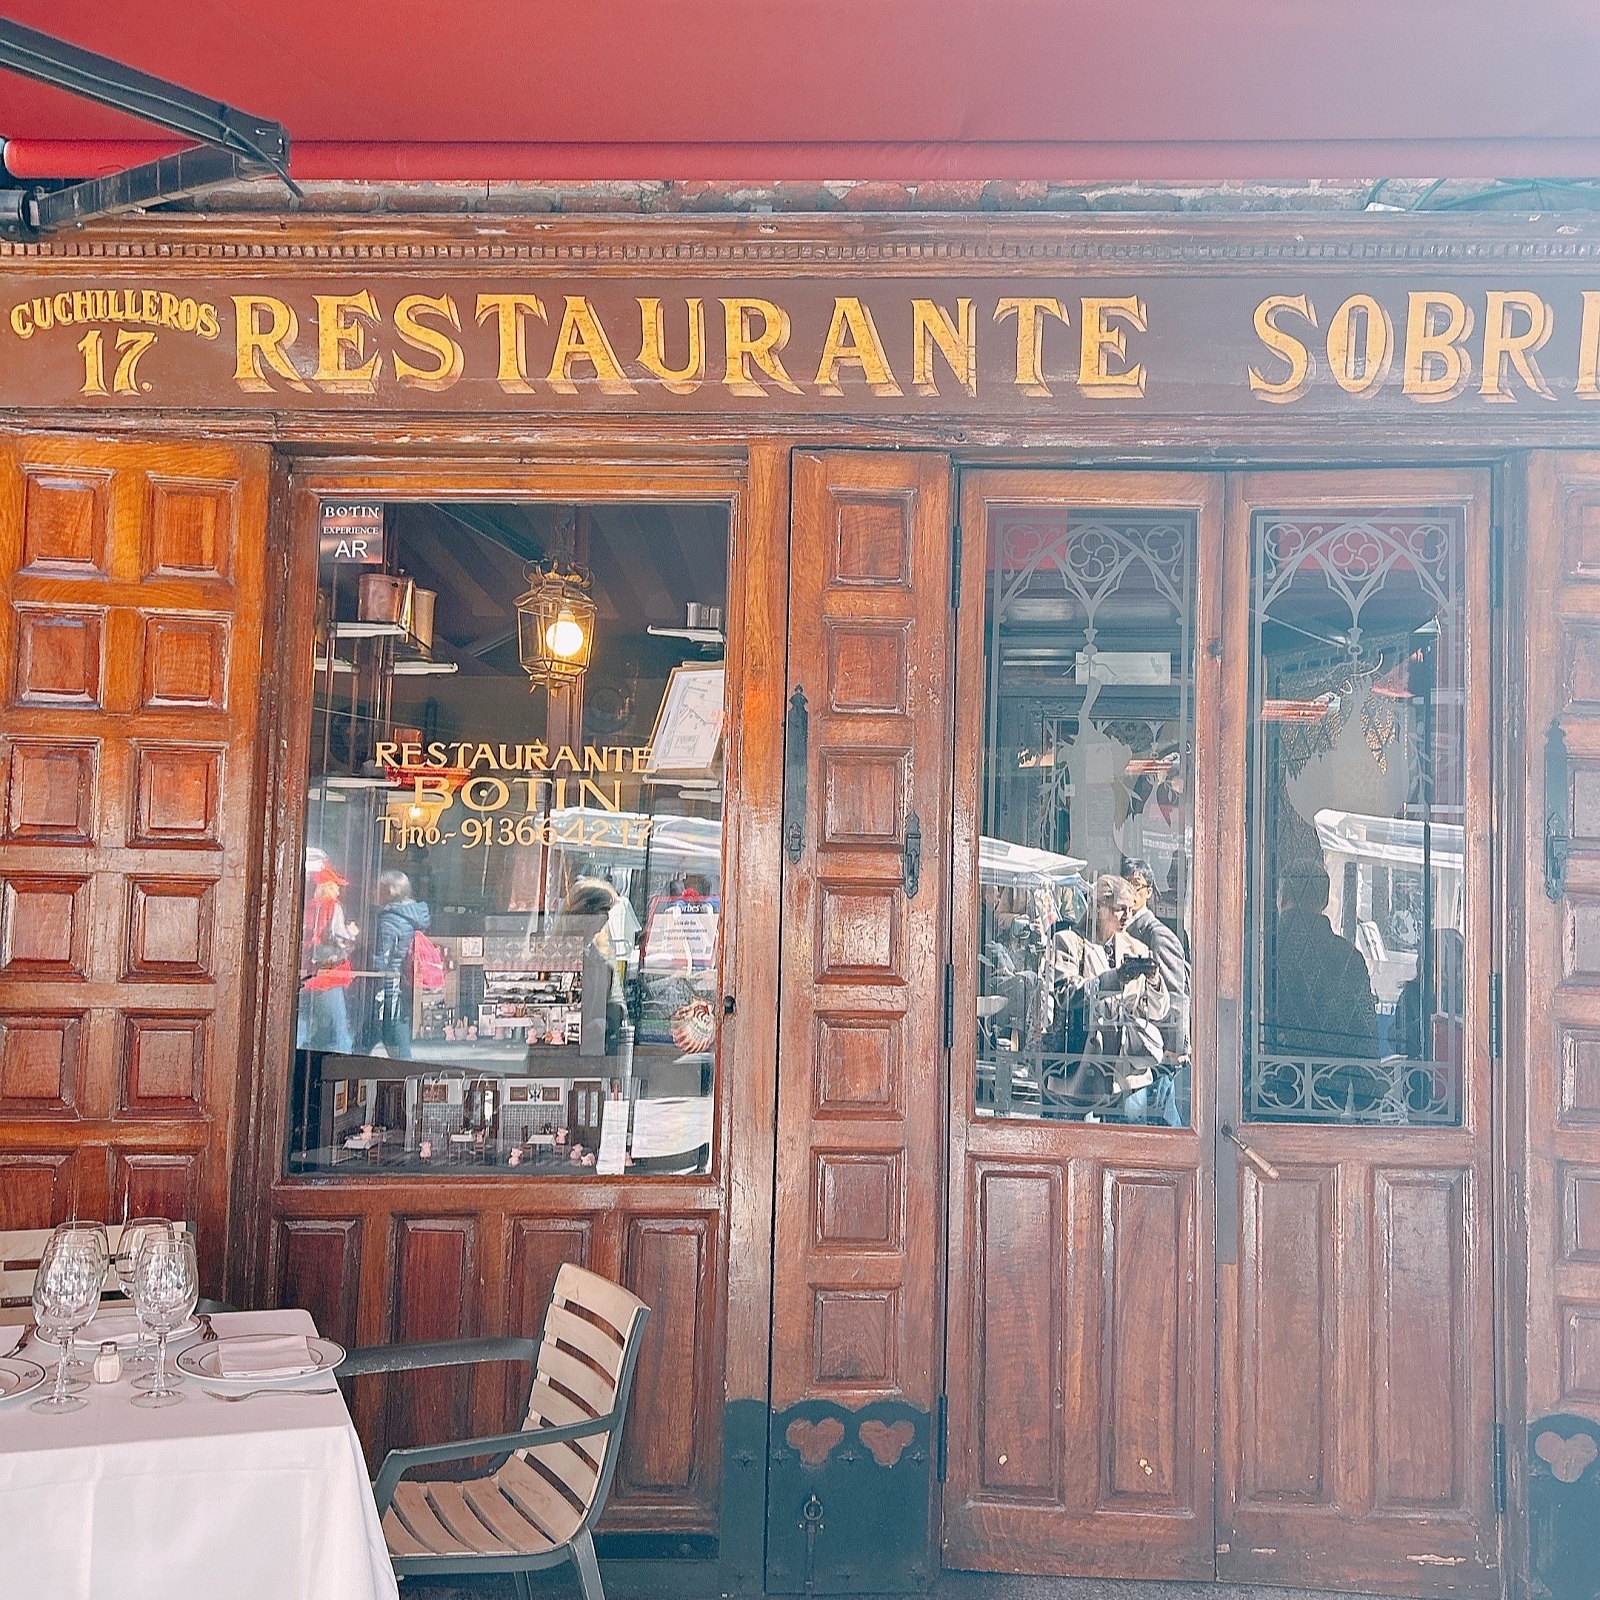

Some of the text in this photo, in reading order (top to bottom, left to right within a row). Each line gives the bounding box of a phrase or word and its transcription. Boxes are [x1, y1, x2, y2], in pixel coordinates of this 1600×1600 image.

[10, 289, 221, 340] CUCHILLEROS
[231, 288, 1149, 399] RESTAURANTE
[323, 505, 380, 519] BOTIN
[323, 526, 379, 535] EXPERIENCE
[334, 539, 369, 559] AR
[375, 741, 658, 773] RESTAURANTE
[414, 776, 622, 812] BOTIN
